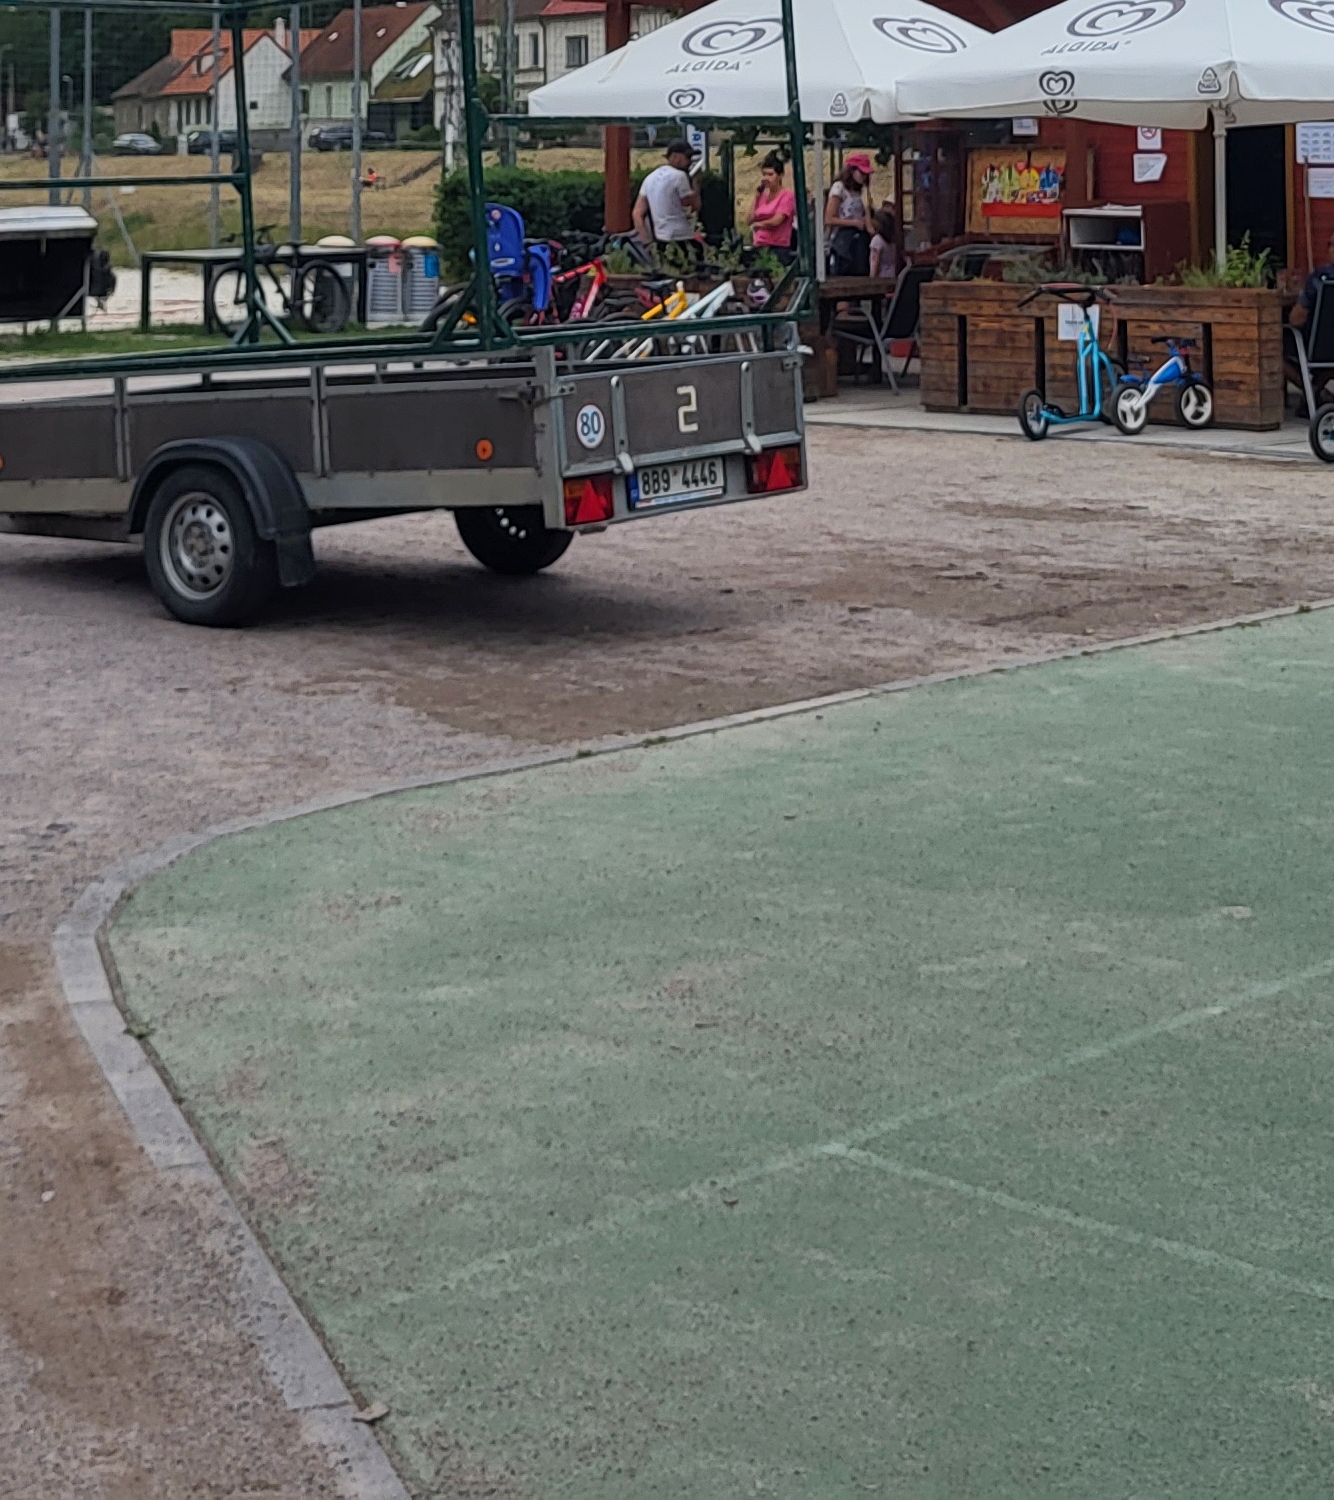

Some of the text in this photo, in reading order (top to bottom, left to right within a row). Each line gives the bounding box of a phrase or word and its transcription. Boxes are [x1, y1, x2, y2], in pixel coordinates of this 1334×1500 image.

[1041, 40, 1119, 55] ALGIDA
[665, 60, 740, 74] ALGIDA
[677, 385, 699, 433] 2
[580, 411, 601, 436] 80
[641, 461, 718, 495] 8B9 4446
